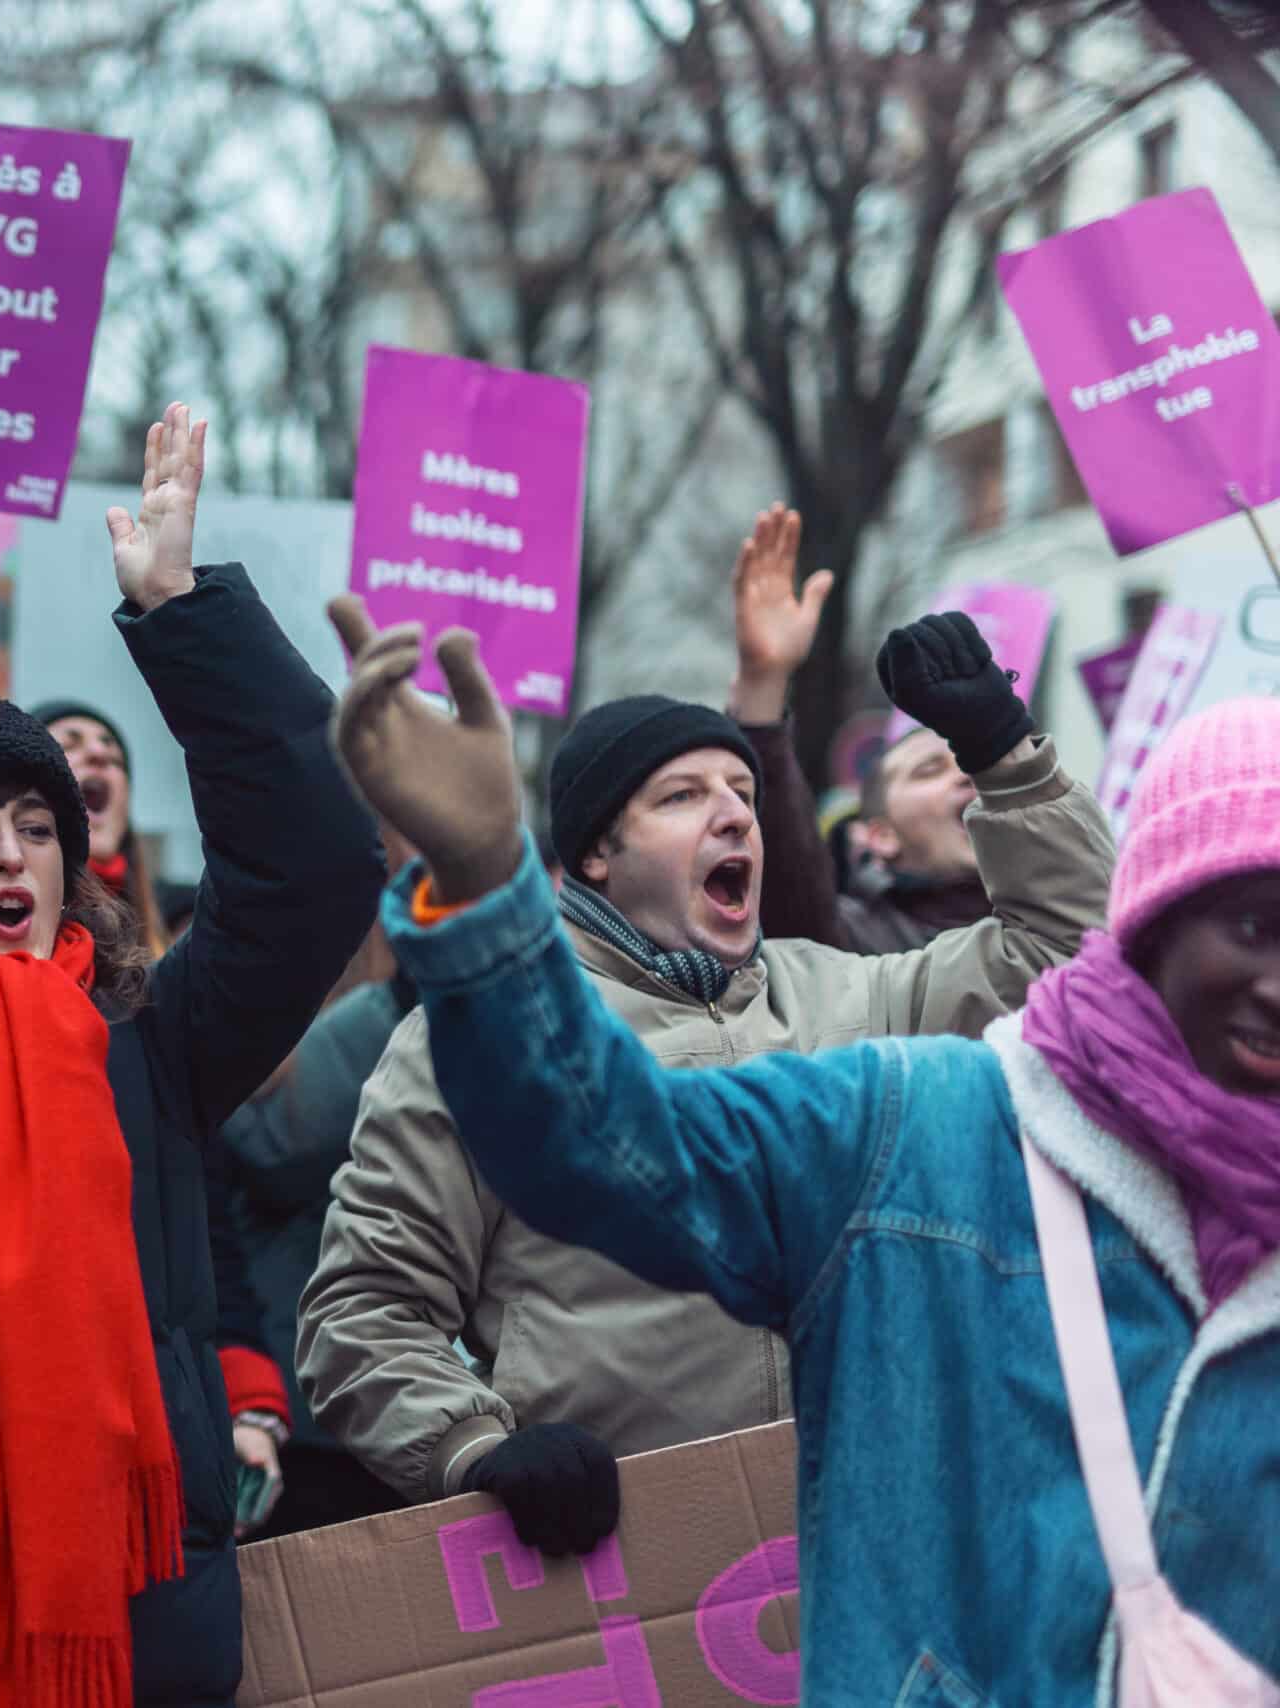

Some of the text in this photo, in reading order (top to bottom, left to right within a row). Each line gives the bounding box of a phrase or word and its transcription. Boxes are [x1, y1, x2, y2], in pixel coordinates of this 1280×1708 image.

[52, 162, 81, 200] à
[1128, 314, 1173, 345] La
[1071, 328, 1260, 412] transphobie
[1155, 387, 1213, 422] tue
[411, 503, 523, 552] isolées
[368, 558, 557, 613] précarisées
